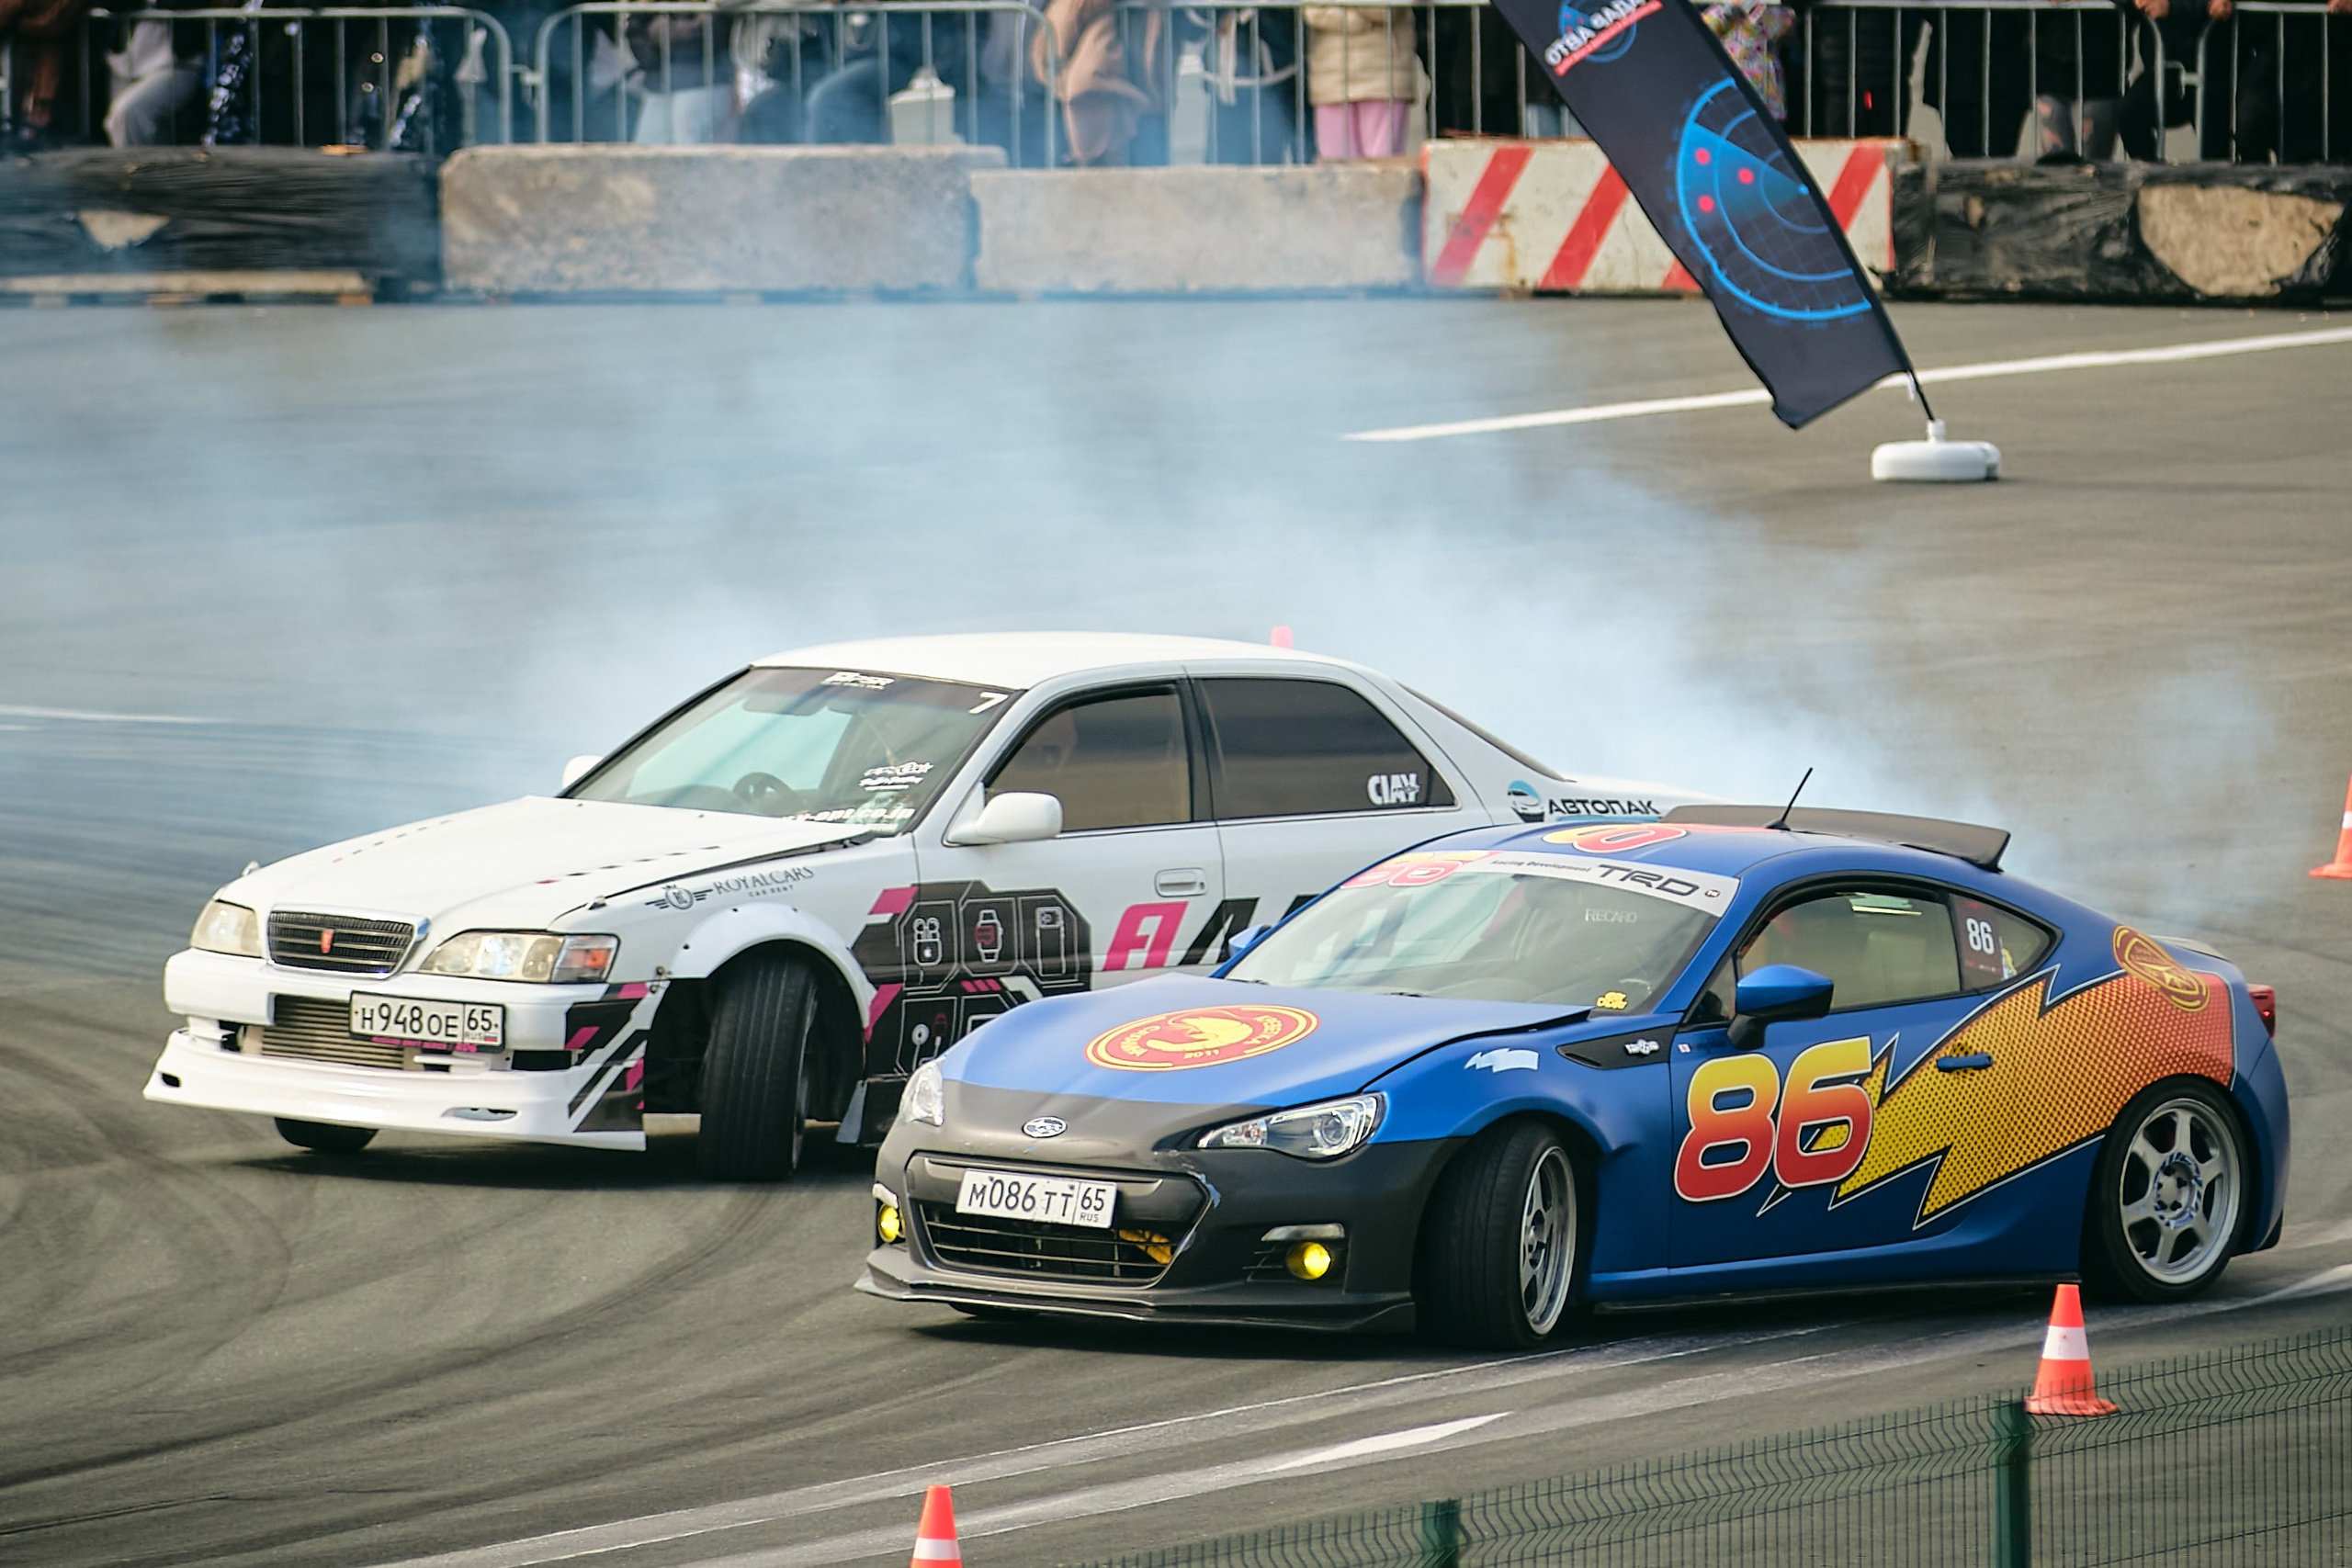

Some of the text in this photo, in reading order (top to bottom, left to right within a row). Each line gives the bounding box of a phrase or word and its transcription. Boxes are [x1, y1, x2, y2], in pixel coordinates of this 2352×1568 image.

[968, 692, 1010, 715] 7
[1547, 798, 1661, 815] АВТОПАК
[1599, 863, 1700, 897] TRD
[1585, 908, 1637, 923] RECARO
[1966, 918, 1995, 955] 86
[467, 1008, 493, 1032] 65
[1674, 1035, 1873, 1202] 86
[1080, 1187, 1106, 1212] 65
[1080, 1213, 1099, 1223] RUS
